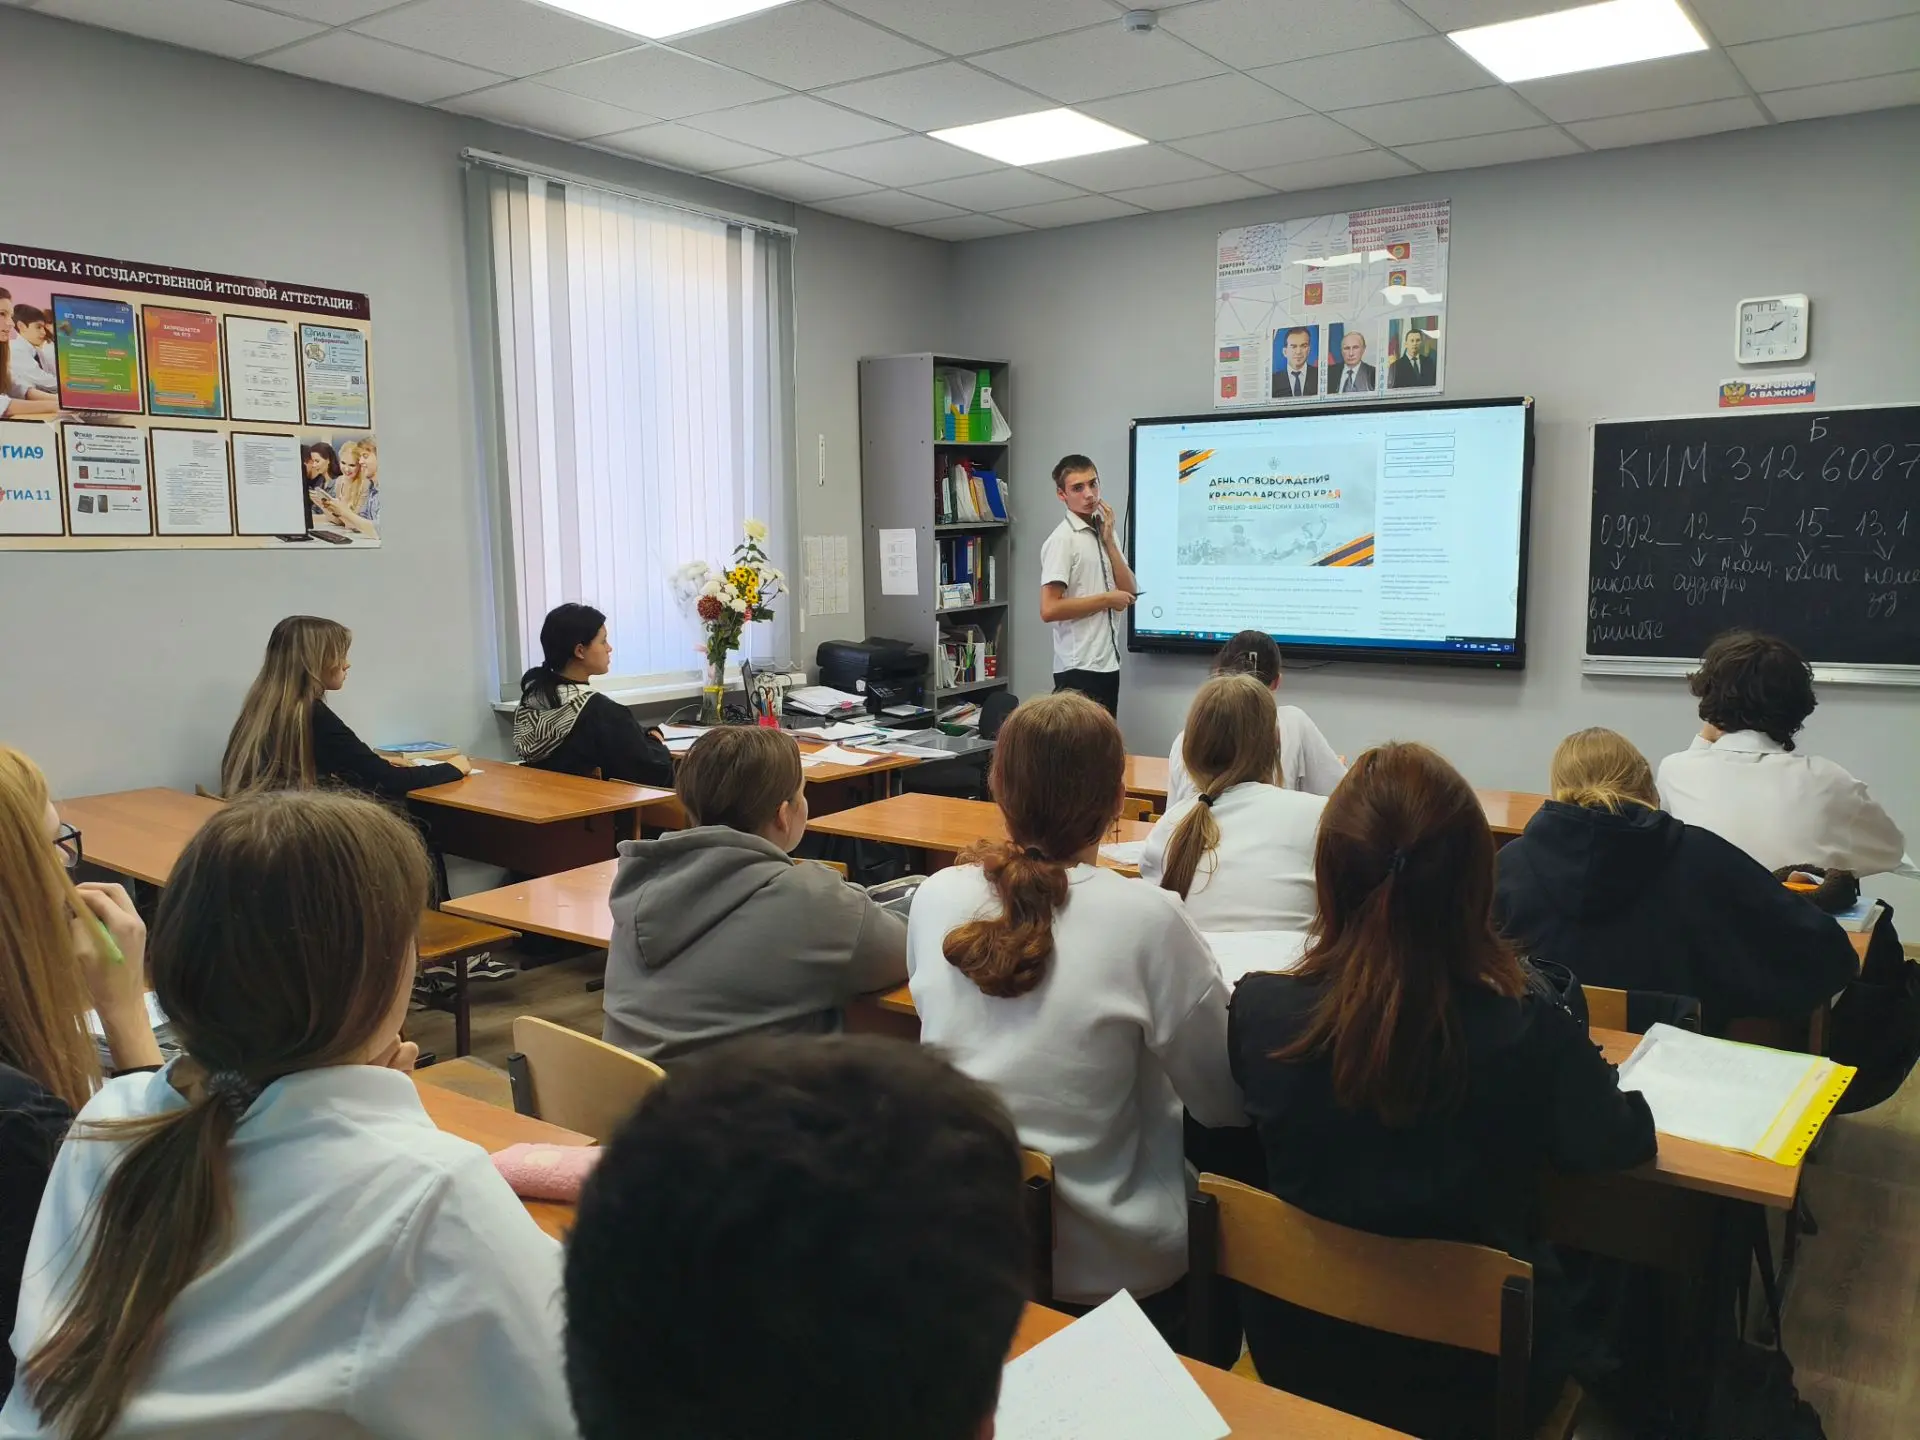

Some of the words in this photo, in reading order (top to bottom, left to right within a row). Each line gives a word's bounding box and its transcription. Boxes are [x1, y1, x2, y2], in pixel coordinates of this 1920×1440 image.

[71, 261, 82, 275] К
[85, 264, 213, 292] ГОСУДАРСТВЕННОЙ
[216, 281, 278, 301] ИТОГОВОЙ
[280, 291, 354, 310] АТТЕСТАЦИИ
[1759, 388, 1807, 397] ВАЖНОМ
[1810, 416, 1830, 442] Б
[2, 445, 44, 460] ГИА9
[1619, 441, 1707, 488] КИМ
[1726, 444, 1804, 481] 312
[1822, 443, 1920, 482] 6087
[1237, 474, 1330, 486] ОСВОБОЖДЕНИЯ
[1591, 573, 1654, 593] школа
